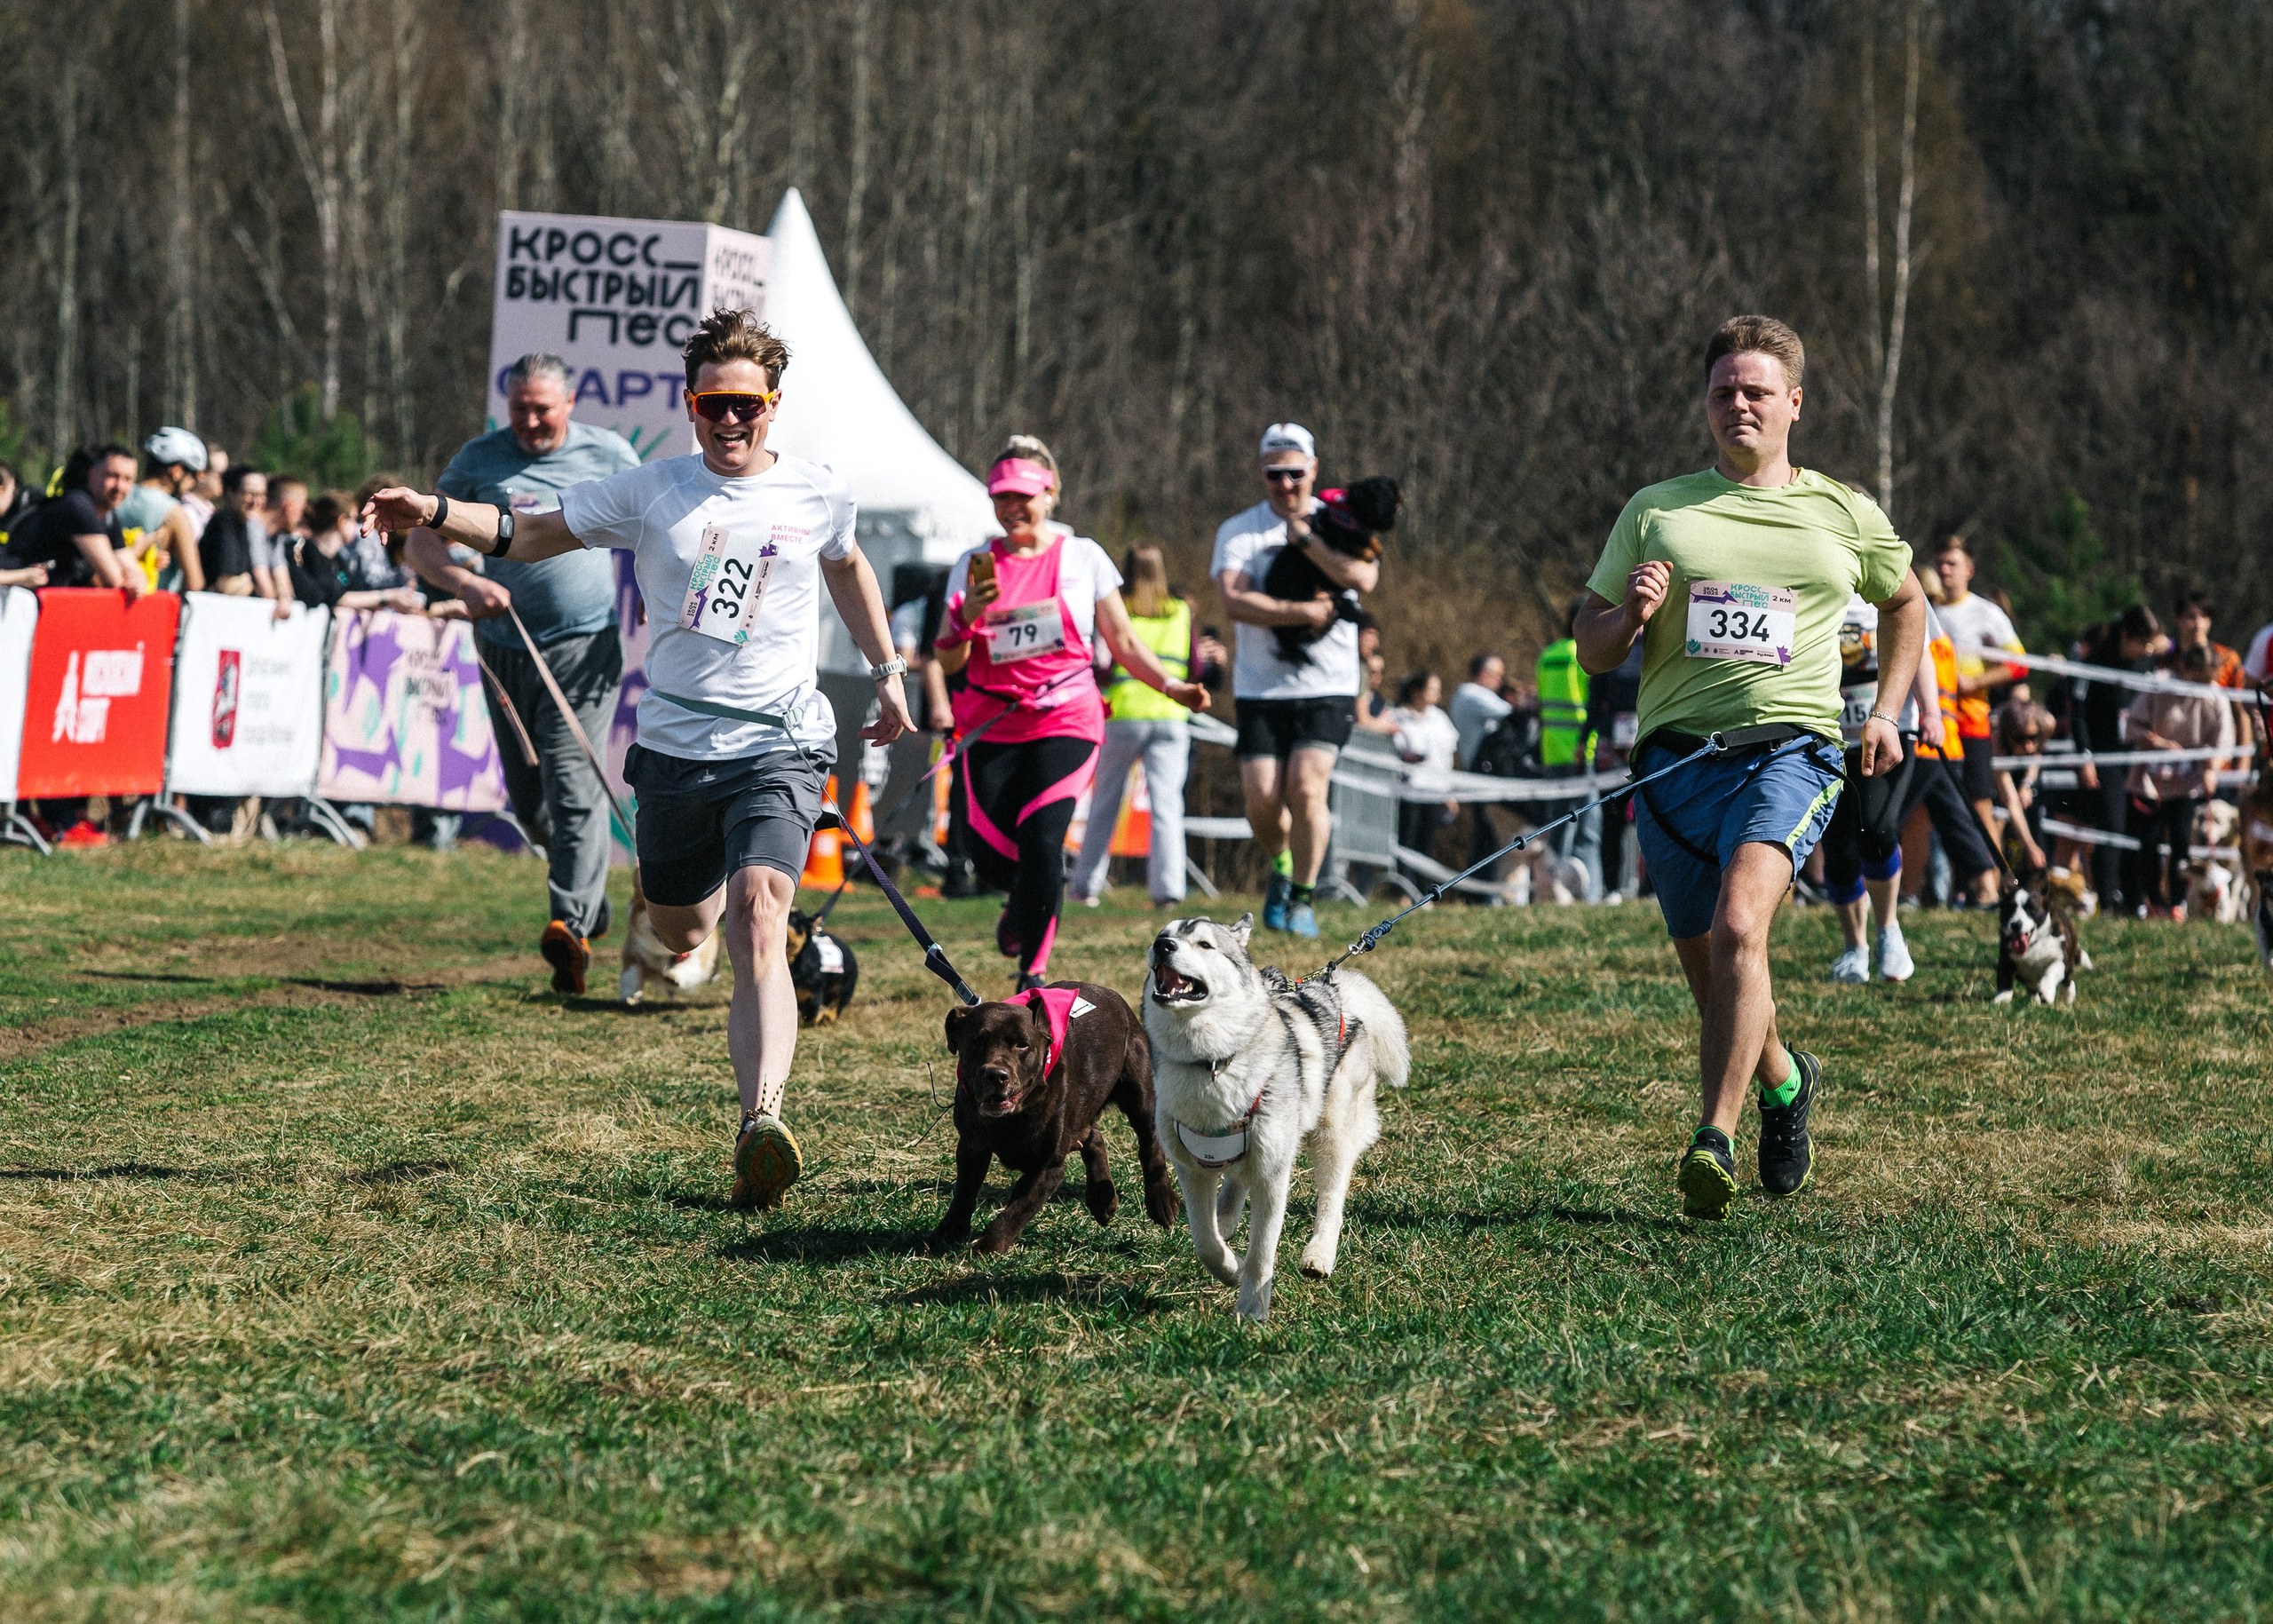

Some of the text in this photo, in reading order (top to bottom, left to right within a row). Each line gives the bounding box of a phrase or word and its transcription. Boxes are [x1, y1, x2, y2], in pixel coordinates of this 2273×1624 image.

[509, 226, 662, 267] КРОСС
[506, 264, 701, 310] БЫСТРЫЙ
[711, 533, 719, 545] КМ
[771, 525, 811, 535] АКТИВНЫ
[771, 533, 803, 544] ВМЕСТЕ
[711, 558, 754, 619] 322
[1009, 623, 1038, 646] 79
[1709, 609, 1770, 642] 334
